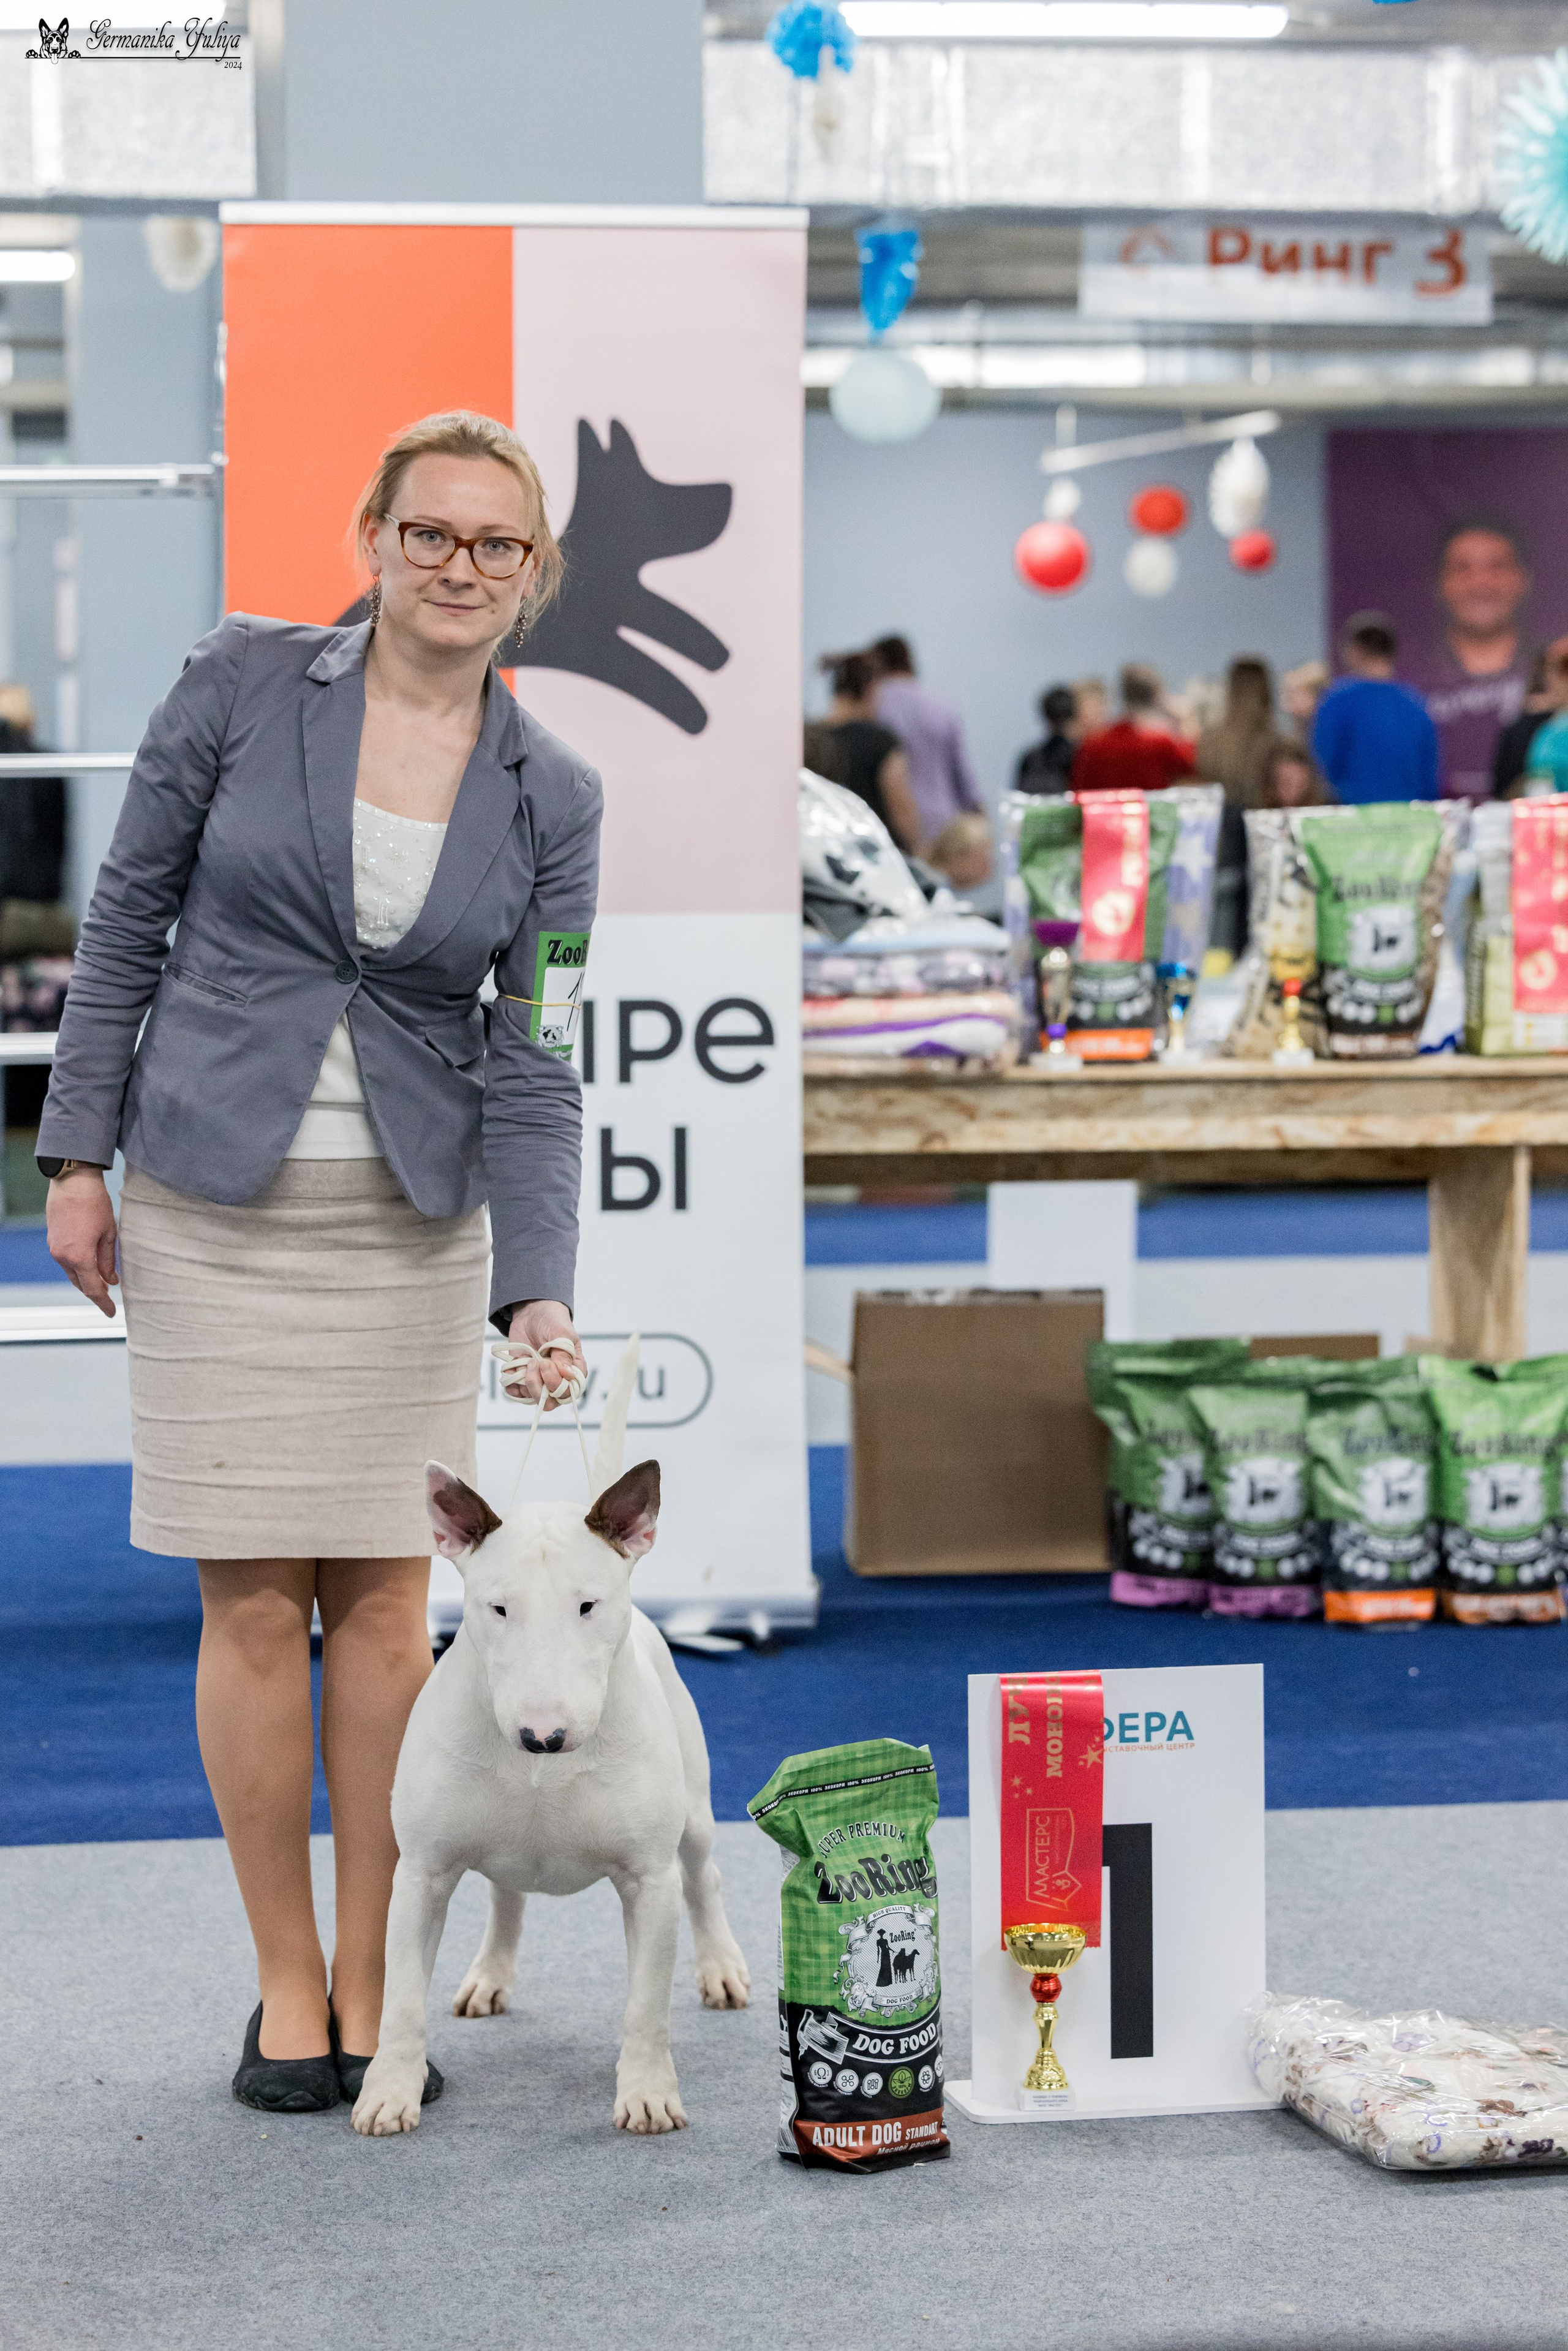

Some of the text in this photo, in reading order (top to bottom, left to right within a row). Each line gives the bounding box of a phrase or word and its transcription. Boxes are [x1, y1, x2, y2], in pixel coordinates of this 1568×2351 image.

[1207, 225, 1468, 298] Ринг 3
[600, 1127, 687, 1211] ы
[1006, 1674, 1031, 1745] ЛУЧ
[1045, 1674, 1063, 1778] МОНОПО
[818, 1821, 906, 1859] SUPER PREMIUM
[814, 1854, 938, 1904] ZooRing
[872, 1909, 884, 1918] HIGH
[889, 1930, 916, 1943] ZooRing
[1102, 1822, 1153, 2059] 1
[852, 2023, 936, 2055] DOG FOOD
[812, 2121, 939, 2148] ADULT DOG STANDART
[876, 2138, 946, 2155] Мясной рацион
